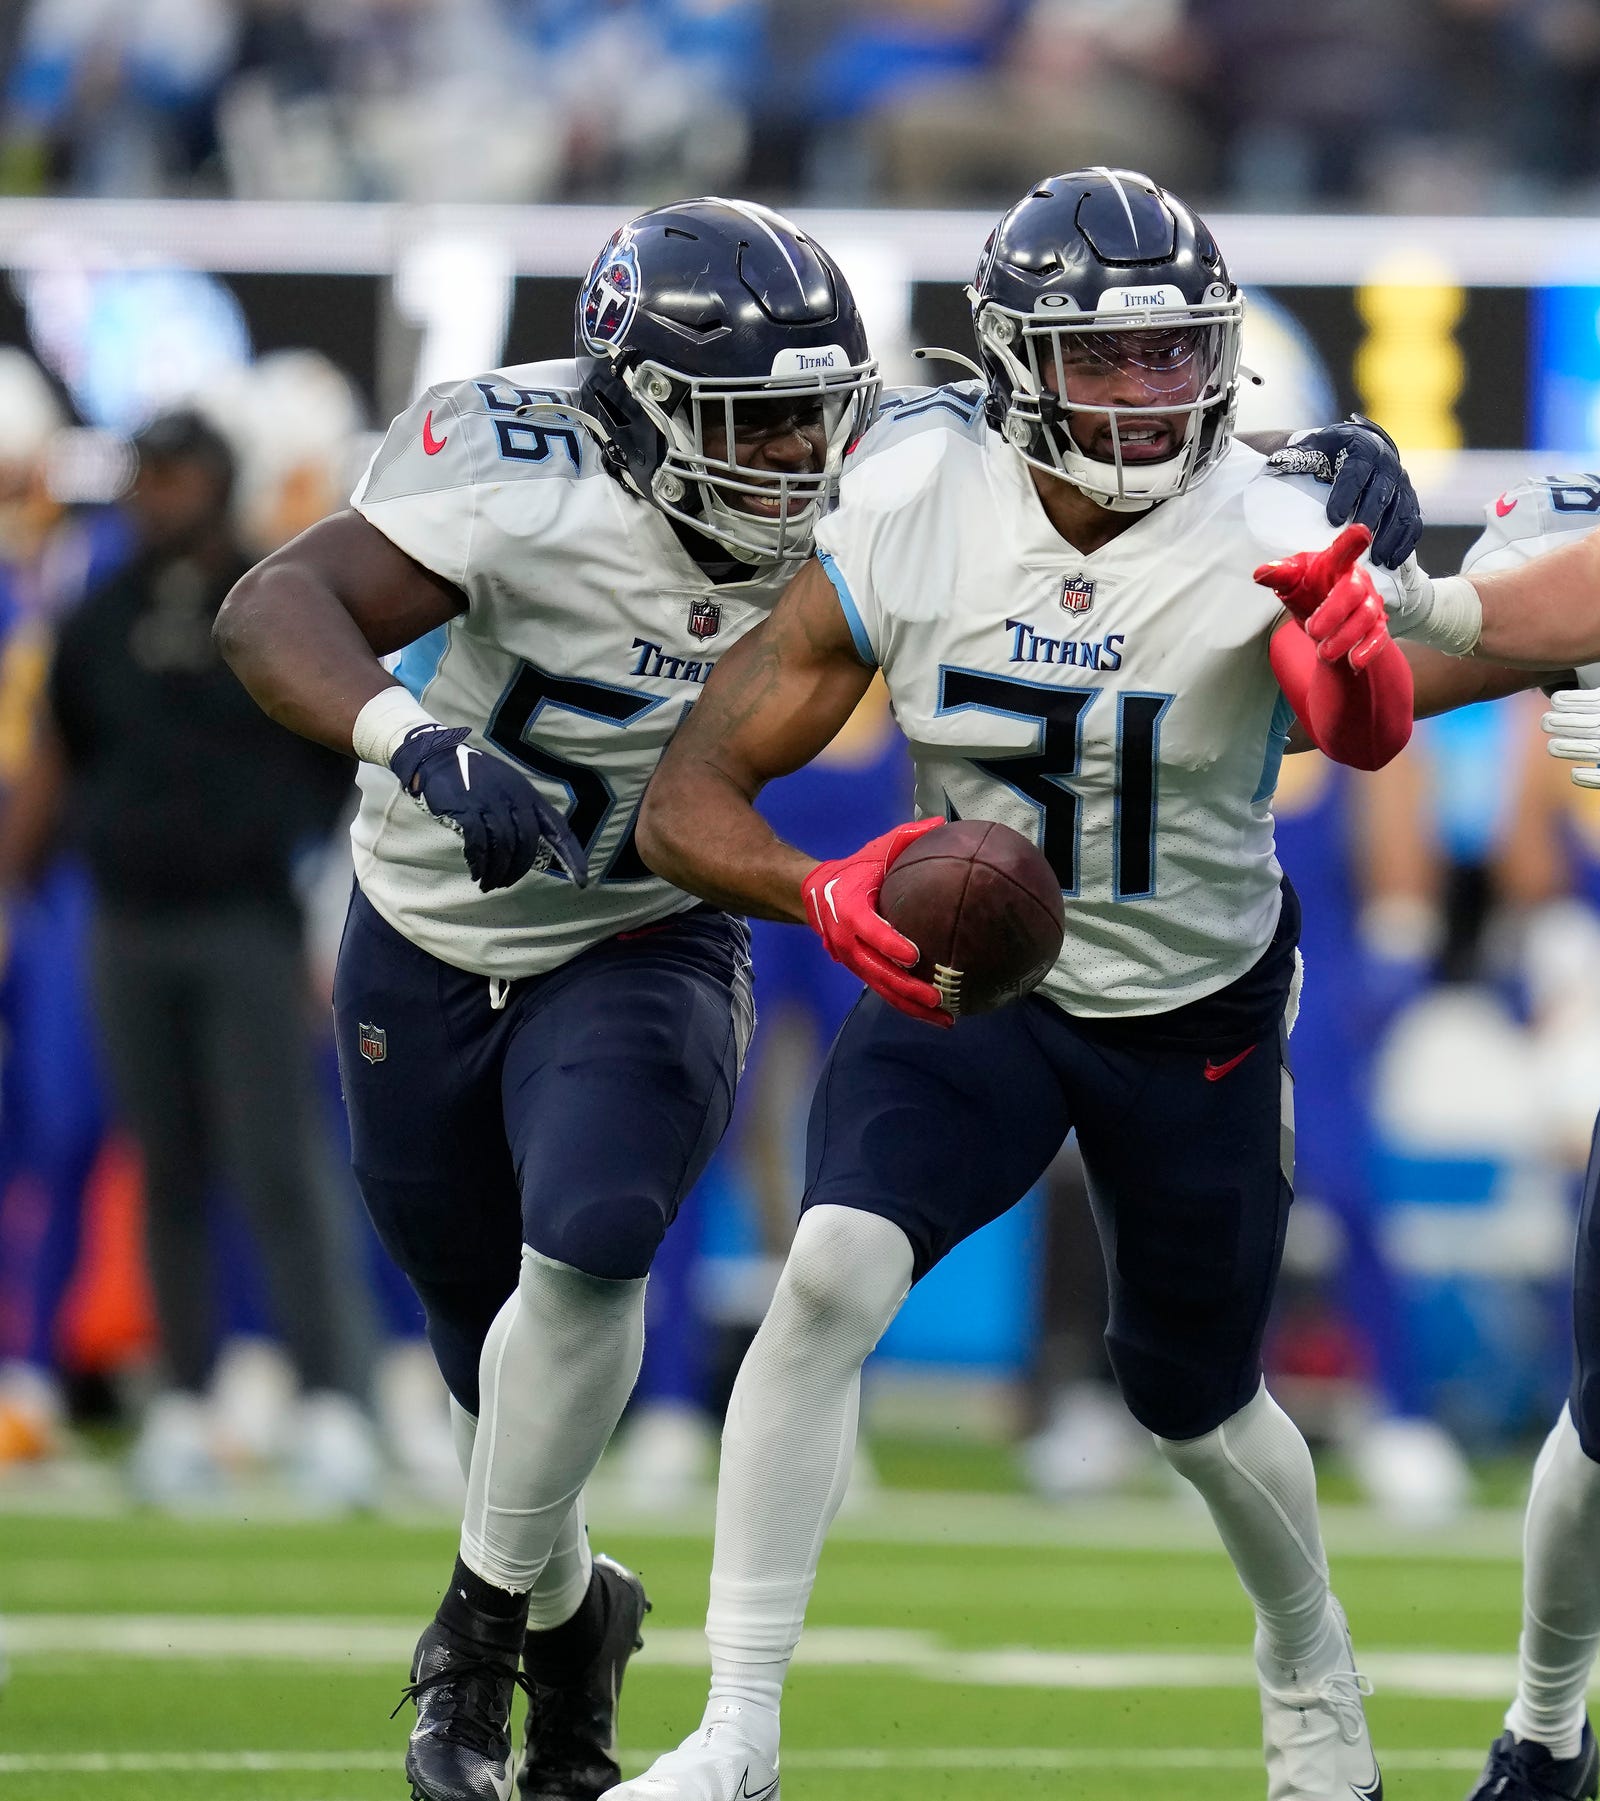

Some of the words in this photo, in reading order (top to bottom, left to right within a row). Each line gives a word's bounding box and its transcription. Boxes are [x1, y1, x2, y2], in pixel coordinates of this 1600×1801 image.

[1120, 290, 1166, 308] TITANS
[796, 351, 834, 370] TITANS
[1064, 590, 1090, 610] NFL
[1006, 618, 1125, 672] TITANS
[482, 656, 698, 885] 5
[934, 663, 1177, 903] 31
[362, 1038, 384, 1058] NFL
